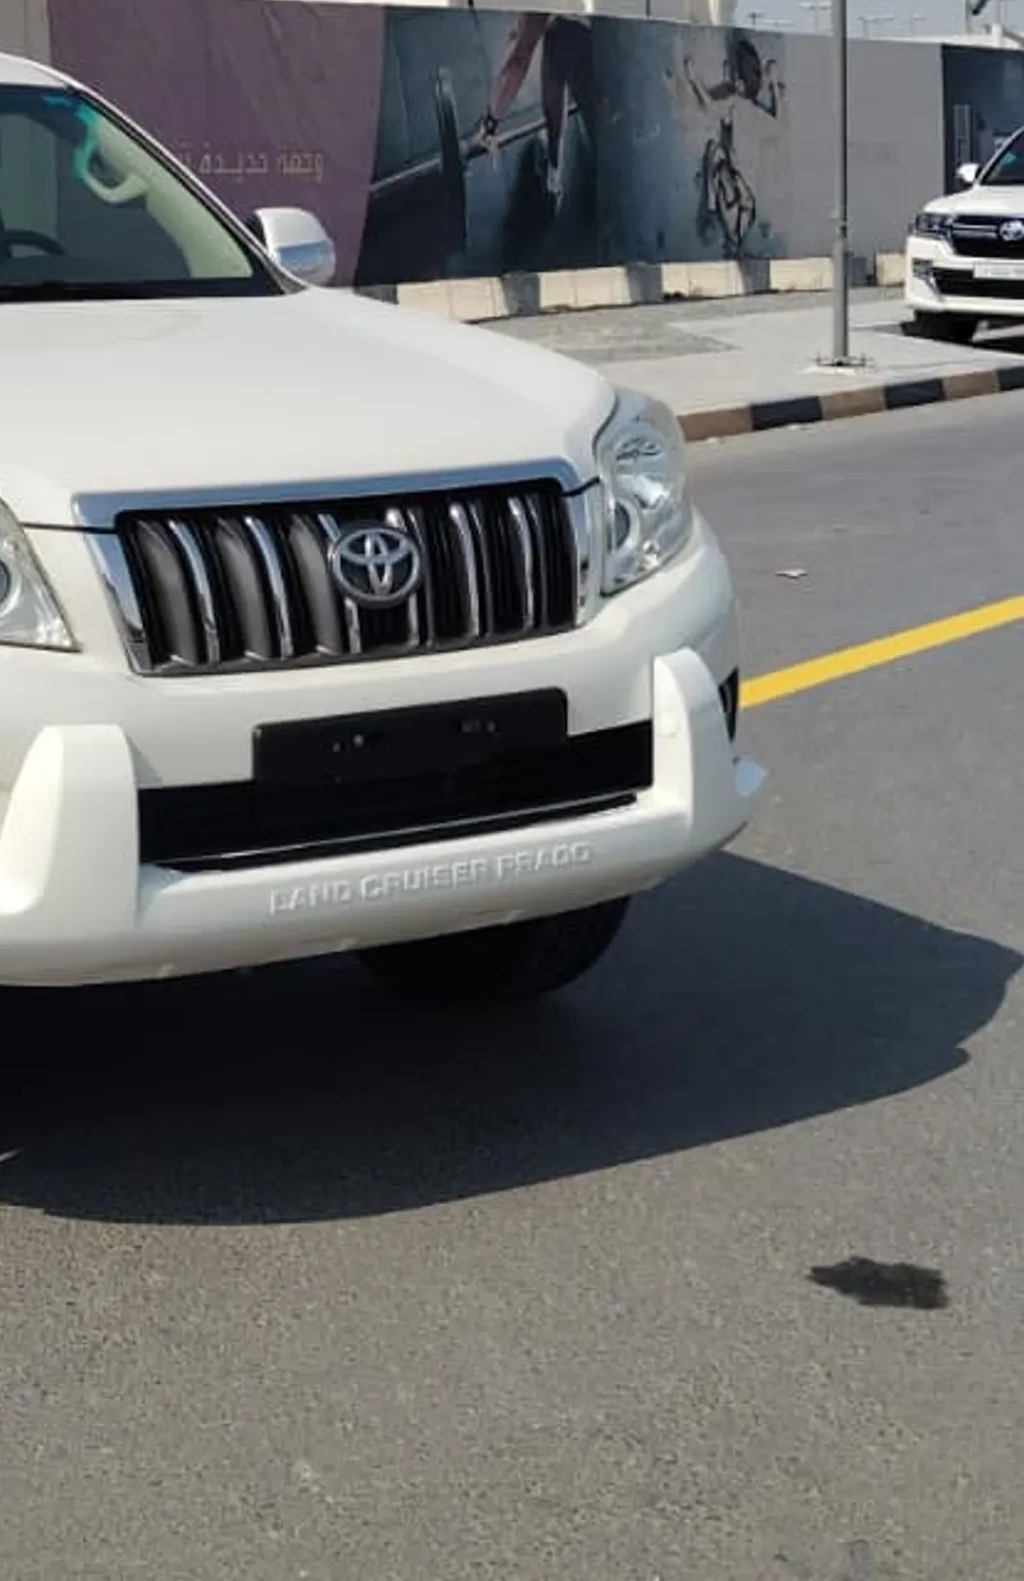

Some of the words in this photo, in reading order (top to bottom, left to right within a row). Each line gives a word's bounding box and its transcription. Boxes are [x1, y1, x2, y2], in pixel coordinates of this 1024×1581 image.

[269, 877, 352, 916] LAND
[359, 856, 487, 900] CRUISER
[496, 841, 592, 879] PRADO
